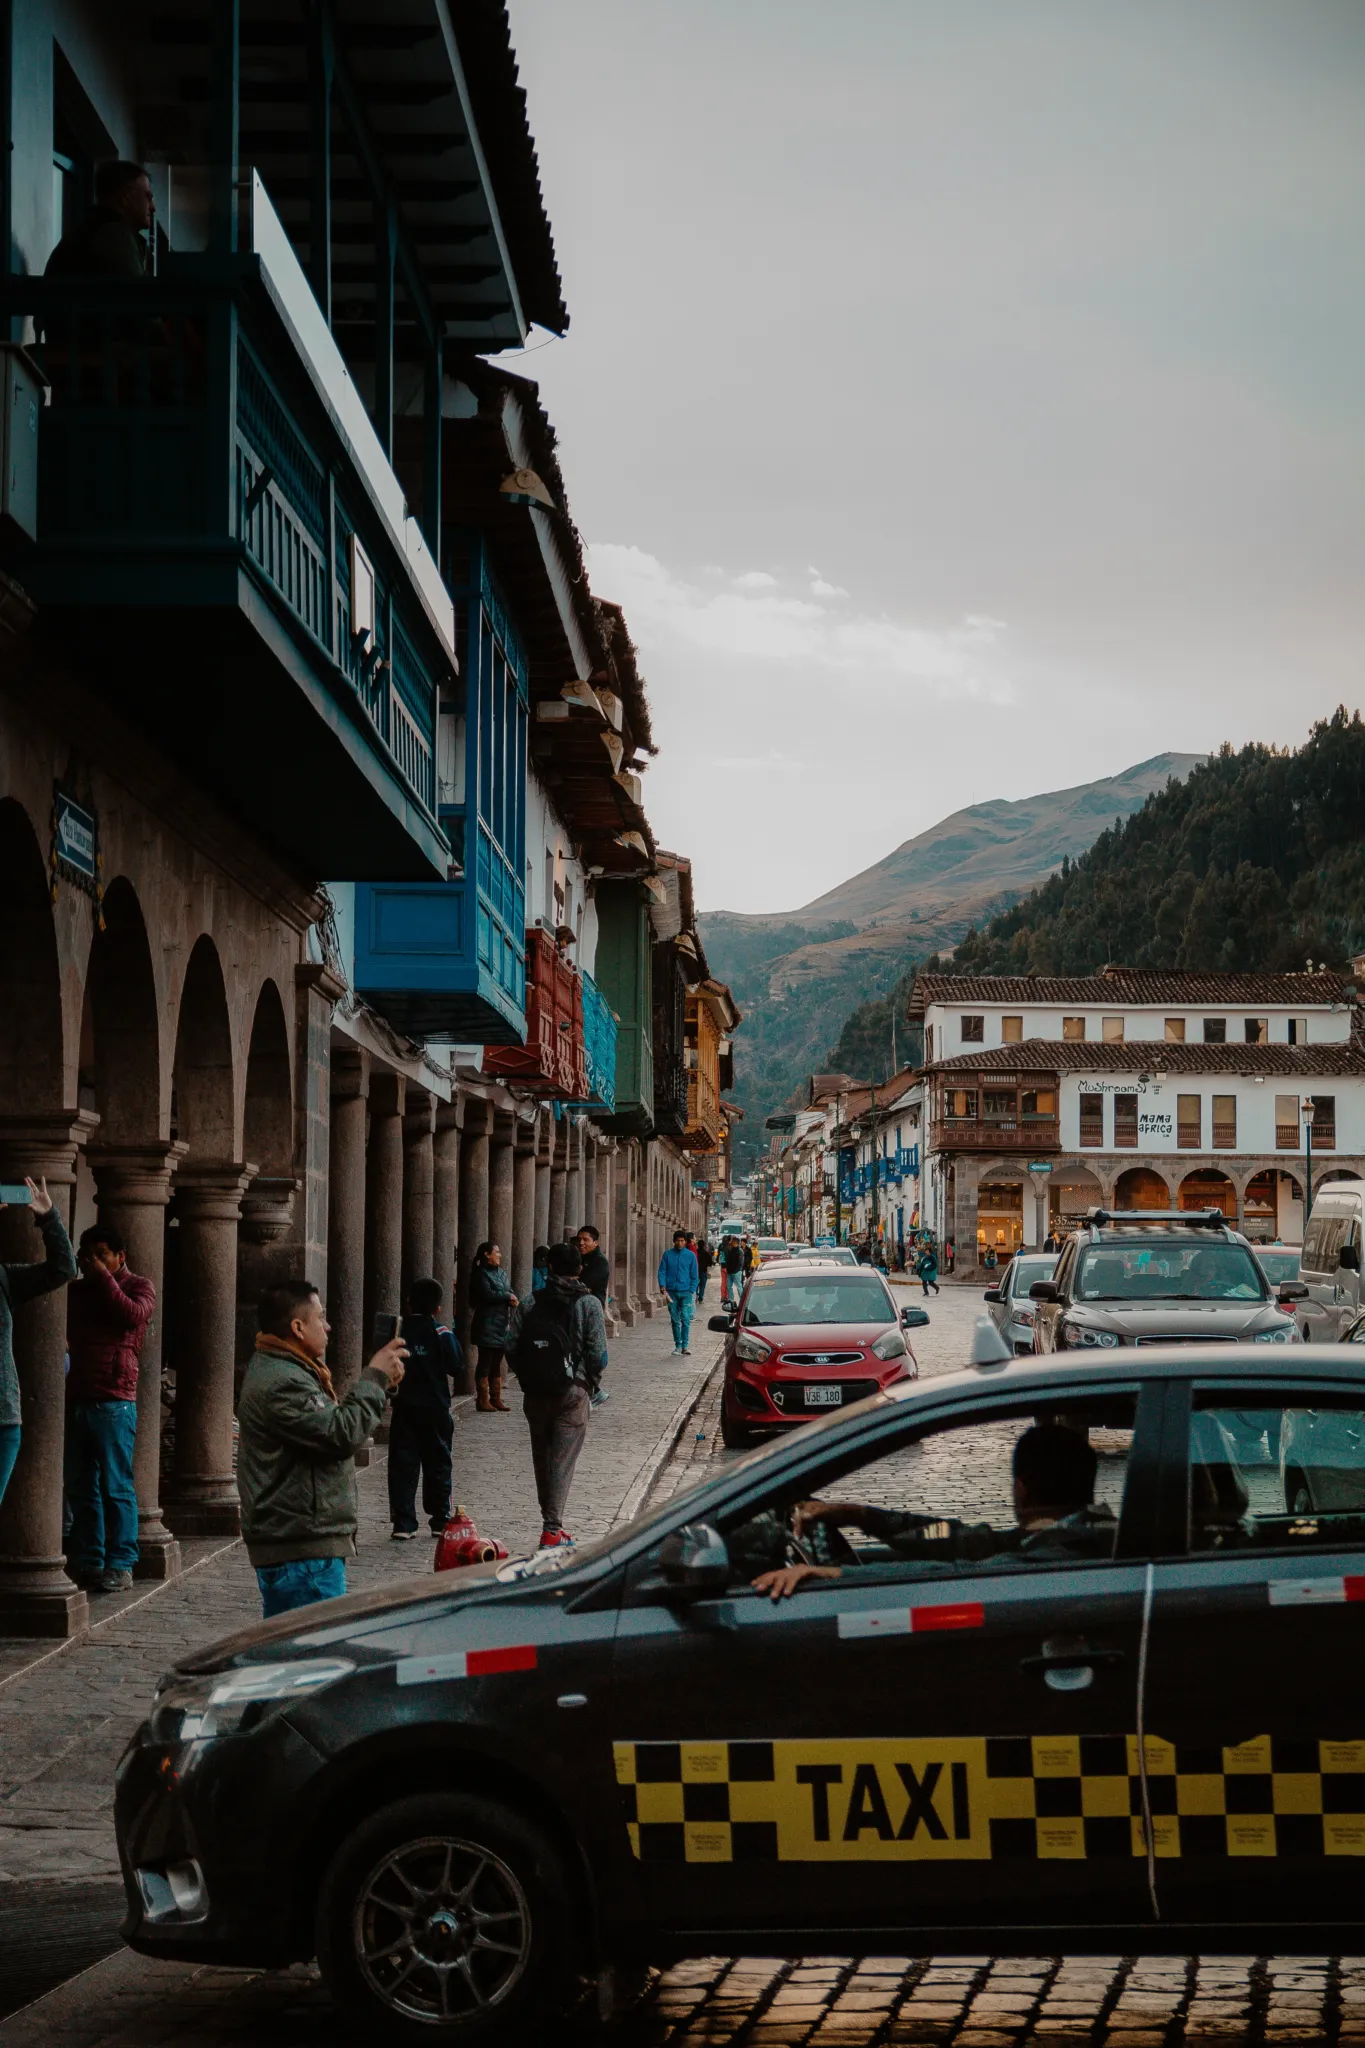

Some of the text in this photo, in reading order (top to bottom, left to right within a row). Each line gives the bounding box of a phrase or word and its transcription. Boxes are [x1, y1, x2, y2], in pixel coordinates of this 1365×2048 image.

[1055, 1215, 1067, 1226] 35
[825, 1391, 840, 1402] 180
[796, 1762, 972, 1842] TAXI
